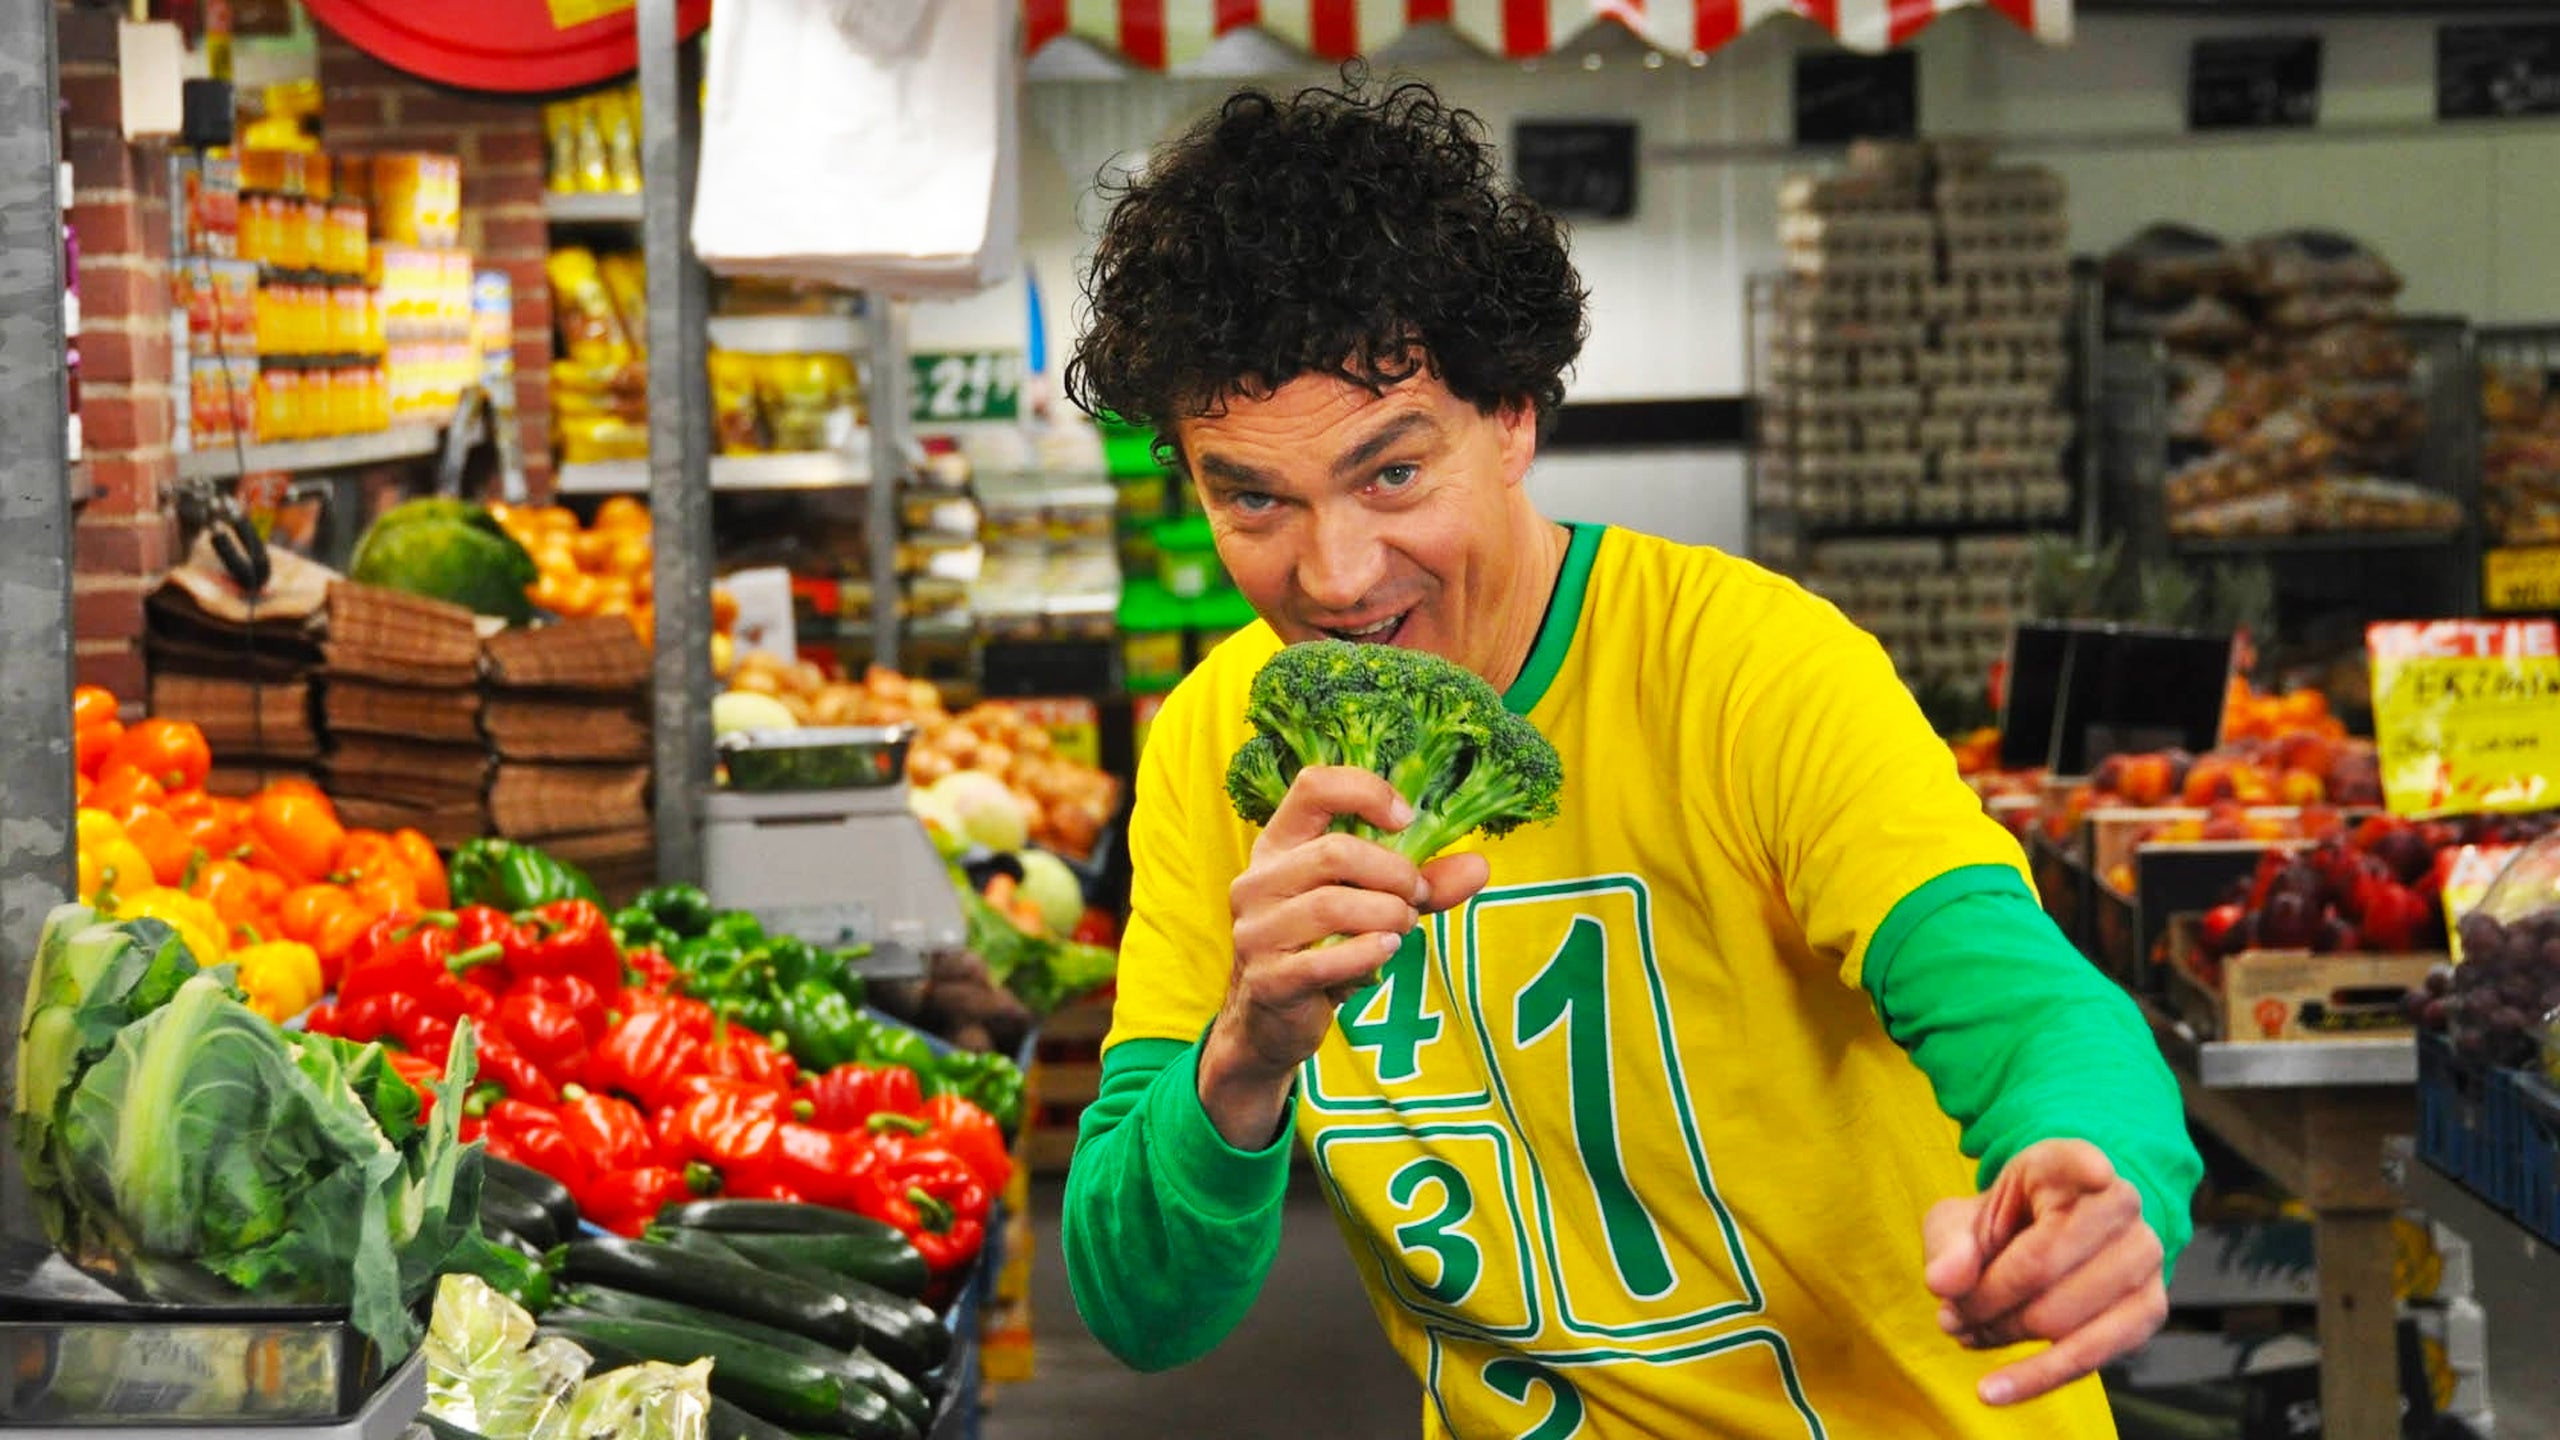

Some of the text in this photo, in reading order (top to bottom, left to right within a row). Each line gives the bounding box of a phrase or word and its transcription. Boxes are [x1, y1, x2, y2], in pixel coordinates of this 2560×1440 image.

[1335, 923, 1444, 1084] 4
[1514, 913, 1680, 1301] 1
[1386, 1155, 1483, 1306] 3
